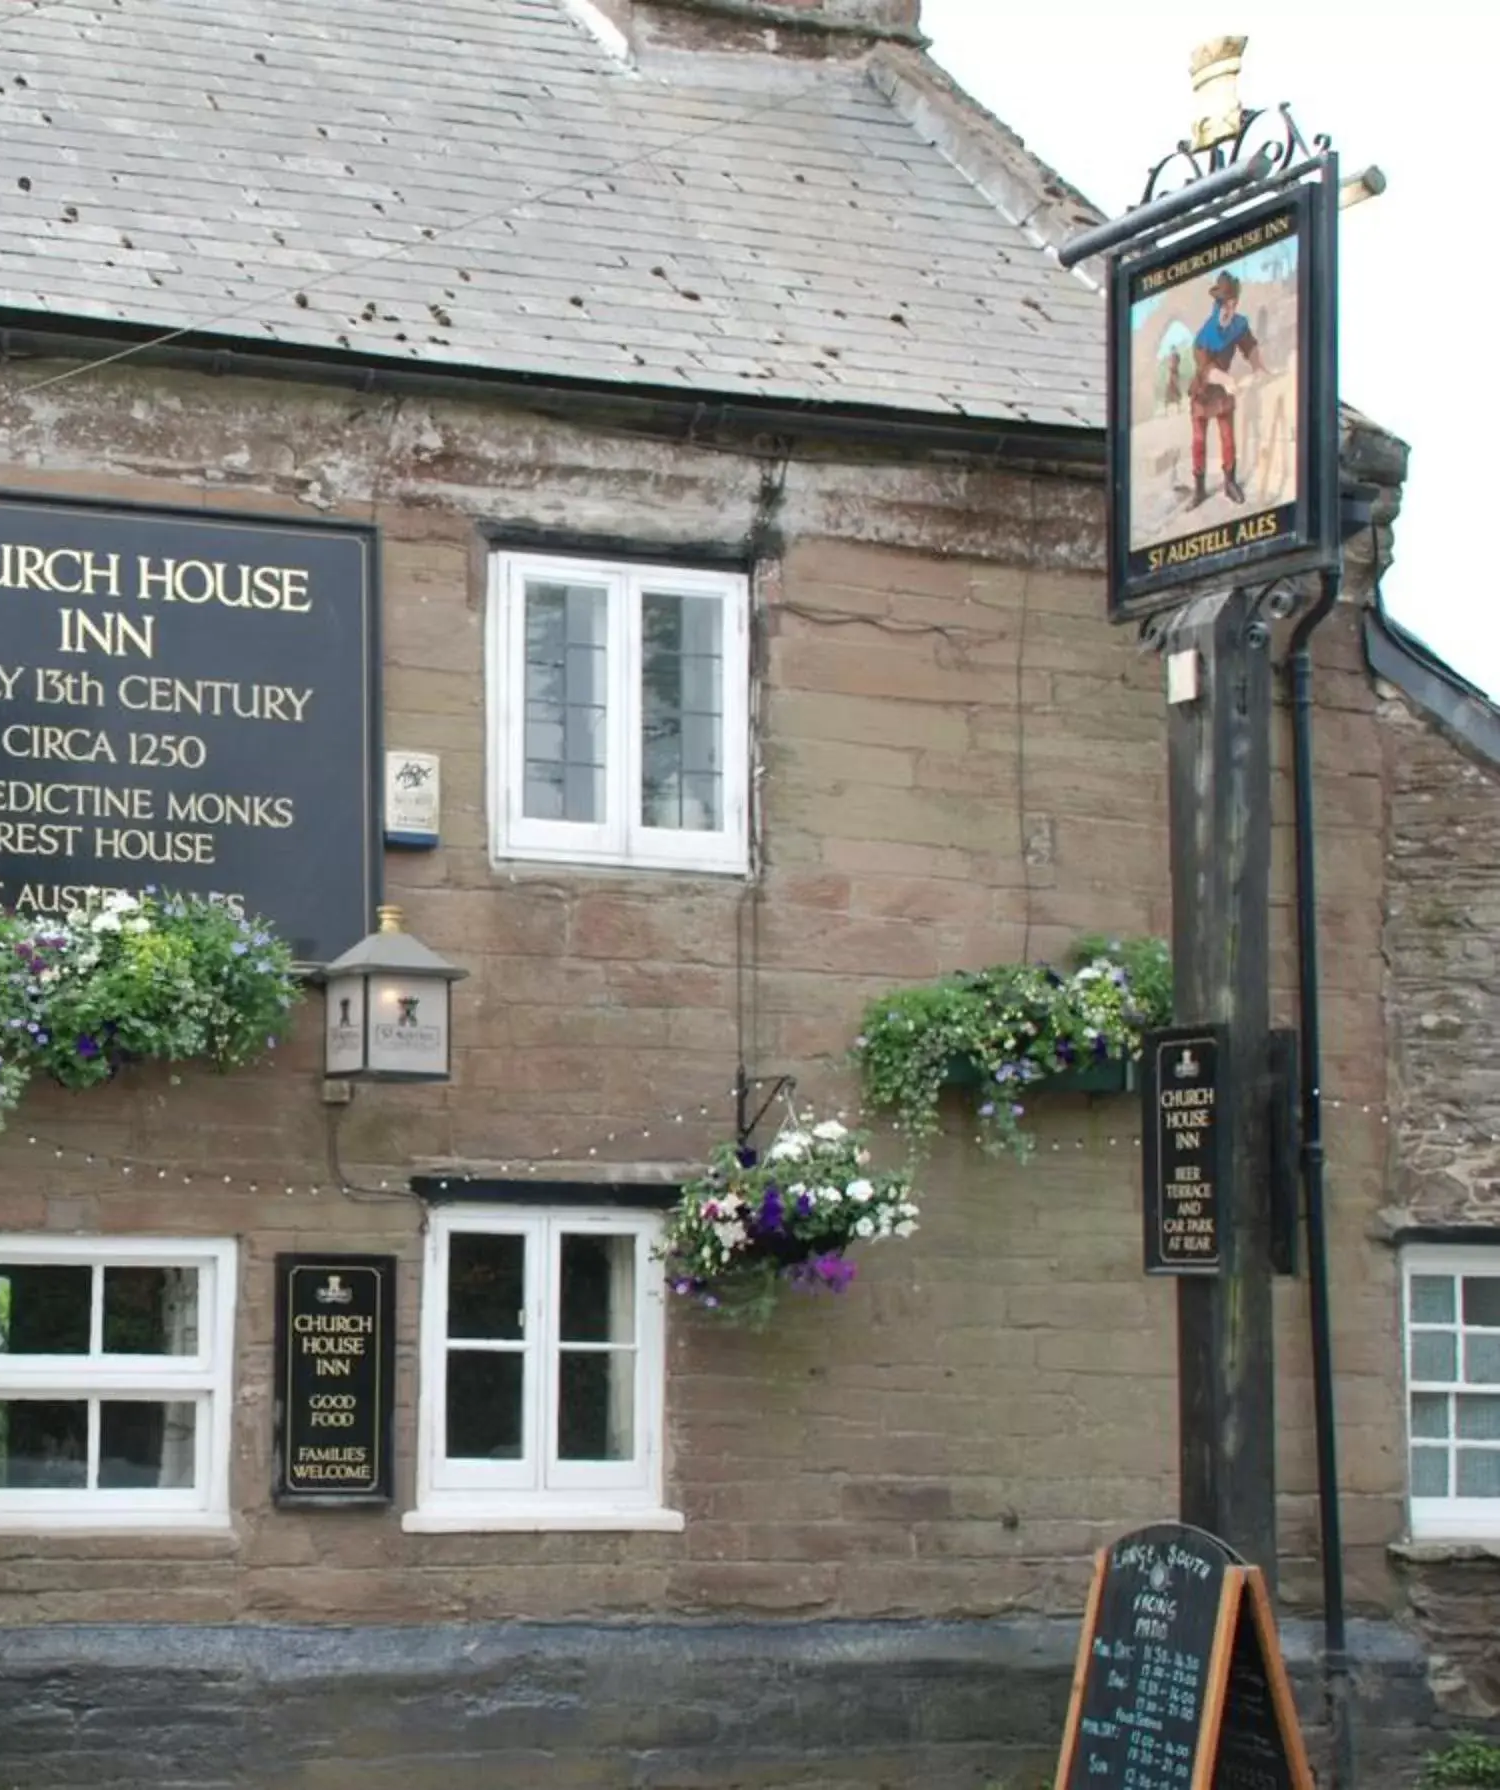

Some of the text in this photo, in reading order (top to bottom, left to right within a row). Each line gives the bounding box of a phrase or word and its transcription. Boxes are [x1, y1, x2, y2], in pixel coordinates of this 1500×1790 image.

[1142, 215, 1290, 291] THE CHURCH HOUSE INN
[1148, 512, 1278, 571] ST AUSTELL ALES
[138, 556, 313, 613] HOUSE
[58, 608, 155, 659] INN
[35, 668, 104, 707] 13th
[118, 675, 313, 722] CENTURY
[2, 725, 207, 769] CIRCA 1250
[166, 793, 294, 829] MONKS
[95, 827, 215, 864] HOUSE
[1161, 1088, 1214, 1108] CHURCH
[1165, 1110, 1210, 1130] HOUSE
[1175, 1132, 1201, 1150] INN
[1174, 1166, 1201, 1181] BEER
[1165, 1183, 1212, 1199] TERRACE
[1177, 1201, 1201, 1216] AND
[1163, 1218, 1214, 1233] CAR PARK
[1168, 1236, 1211, 1251] AT REAR
[294, 1314, 373, 1334] CHURCH
[302, 1336, 365, 1355] HOUSE
[316, 1358, 350, 1376] INN
[309, 1393, 356, 1410] GOOD
[310, 1411, 354, 1427] FOOD
[299, 1447, 366, 1462] FAMILIES
[293, 1464, 371, 1480] WELCOME
